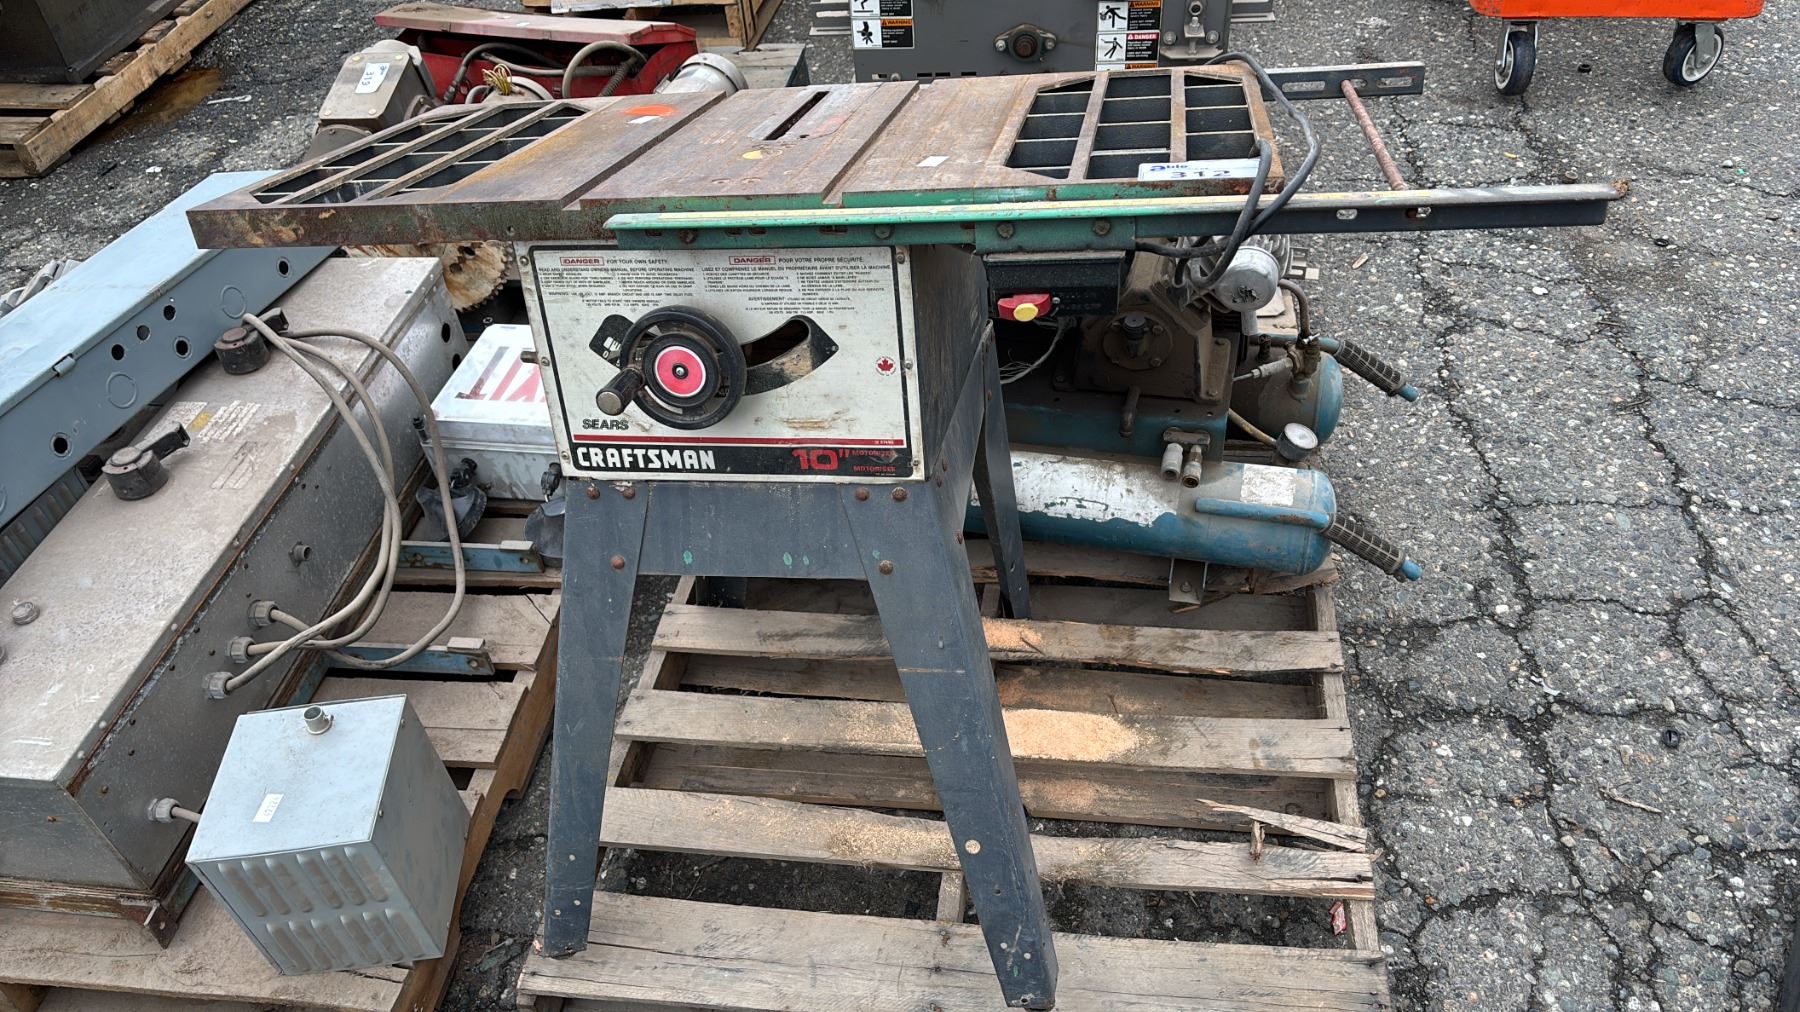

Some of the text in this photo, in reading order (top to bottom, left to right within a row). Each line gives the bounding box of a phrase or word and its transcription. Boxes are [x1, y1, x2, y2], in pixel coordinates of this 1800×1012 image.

[1171, 170, 1231, 178] 312
[582, 418, 629, 431] SEARS
[576, 447, 716, 470] CRAFTSMAN
[792, 448, 850, 471] 10"
